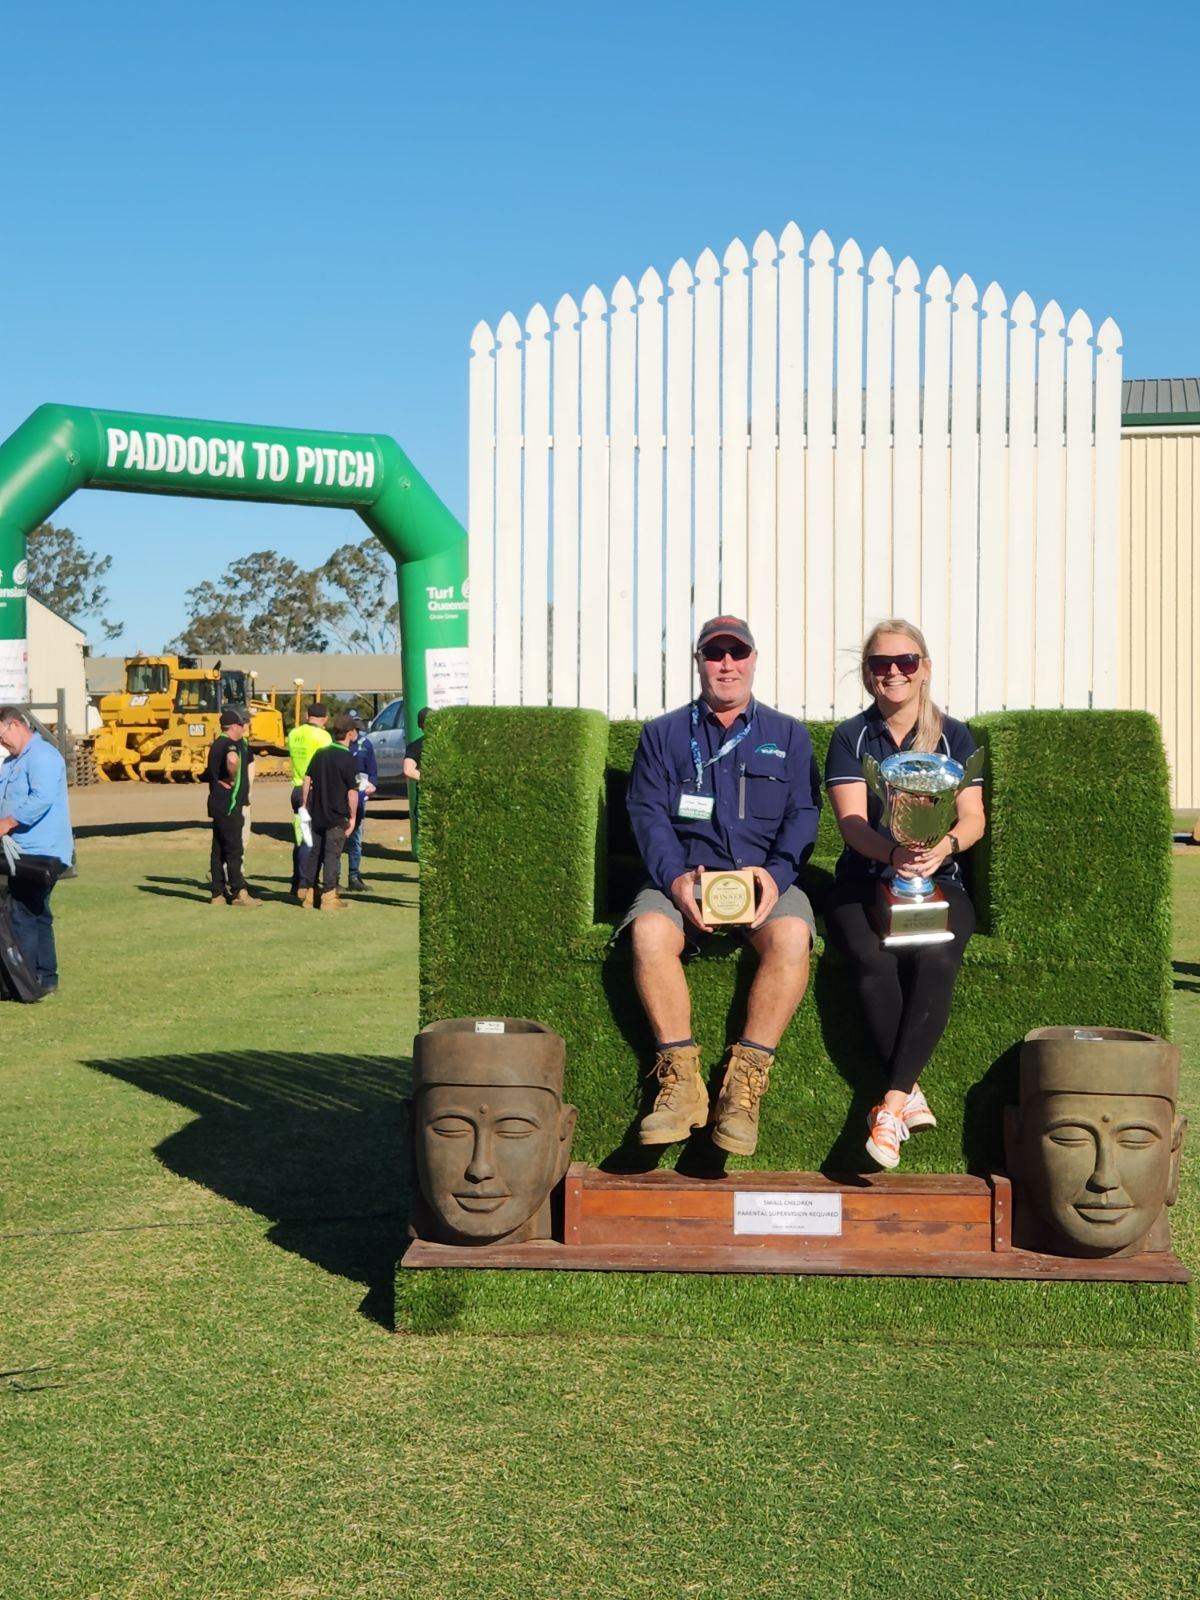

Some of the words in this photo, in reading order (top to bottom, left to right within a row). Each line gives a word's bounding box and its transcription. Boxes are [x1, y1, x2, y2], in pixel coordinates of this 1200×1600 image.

[106, 427, 246, 479] PADDOCK
[252, 442, 290, 482] TO
[295, 446, 375, 488] PITCH
[425, 586, 454, 599] Turf
[190, 725, 204, 734] CAT
